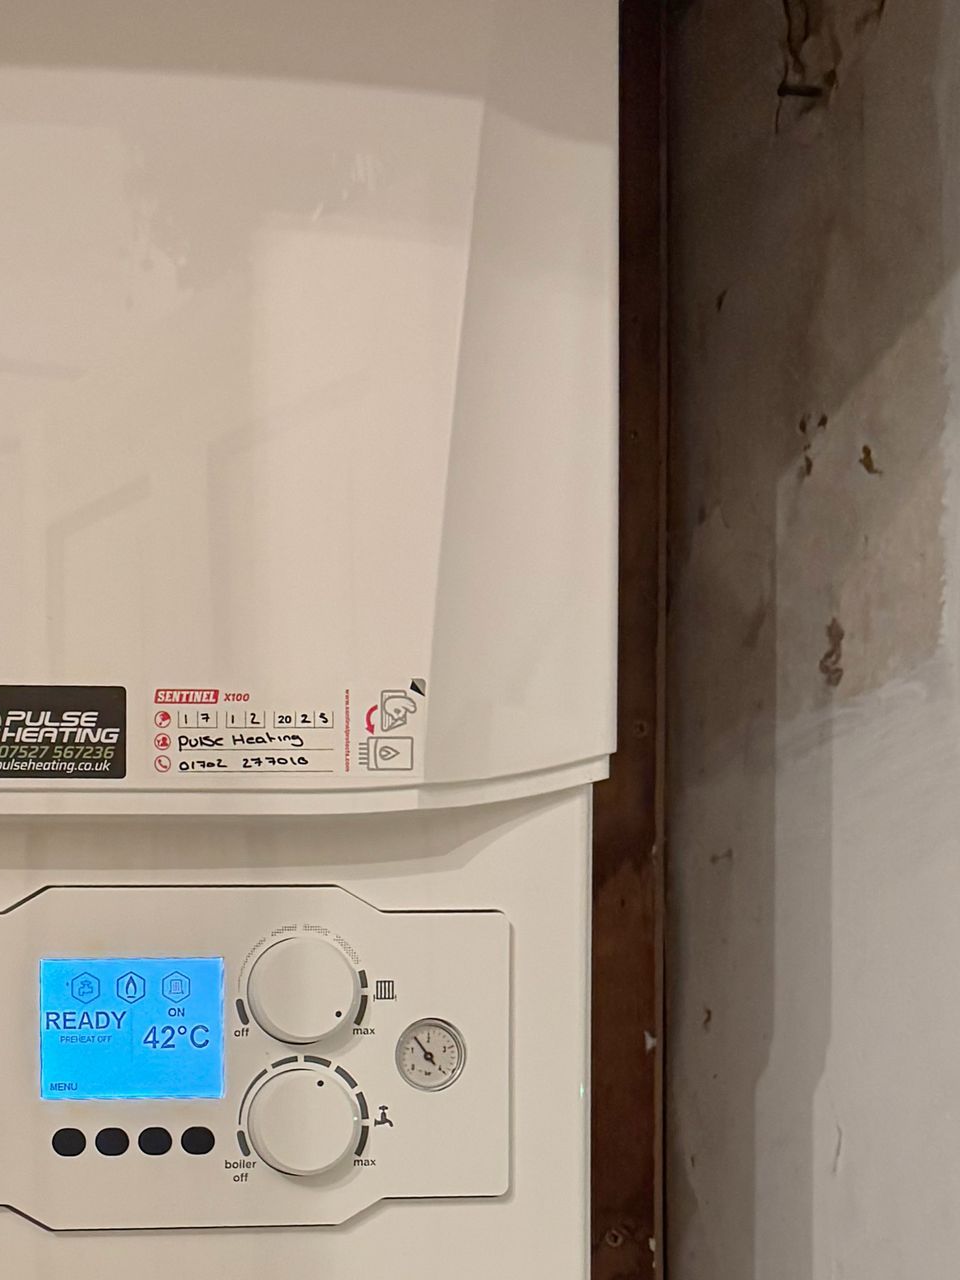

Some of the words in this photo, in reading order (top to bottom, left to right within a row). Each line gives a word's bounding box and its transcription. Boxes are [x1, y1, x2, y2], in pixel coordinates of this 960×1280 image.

[156, 690, 219, 704] SENTINEL
[224, 692, 250, 702] X100
[5, 711, 99, 727] PULSE
[1, 727, 120, 743] HEATING
[232, 732, 304, 747] Heating
[52, 745, 115, 759] 567236
[179, 758, 228, 771] 01702
[168, 1007, 186, 1017] ON
[45, 1011, 127, 1030] READY
[143, 1024, 210, 1049] 42°C
[234, 1028, 250, 1037] off
[352, 1027, 376, 1036] max
[60, 1035, 95, 1044] PREHEAT
[97, 1035, 113, 1043] OFF
[49, 1082, 78, 1092] MENU
[224, 1159, 257, 1170] boiler
[353, 1158, 377, 1167] max
[233, 1172, 249, 1183] off
